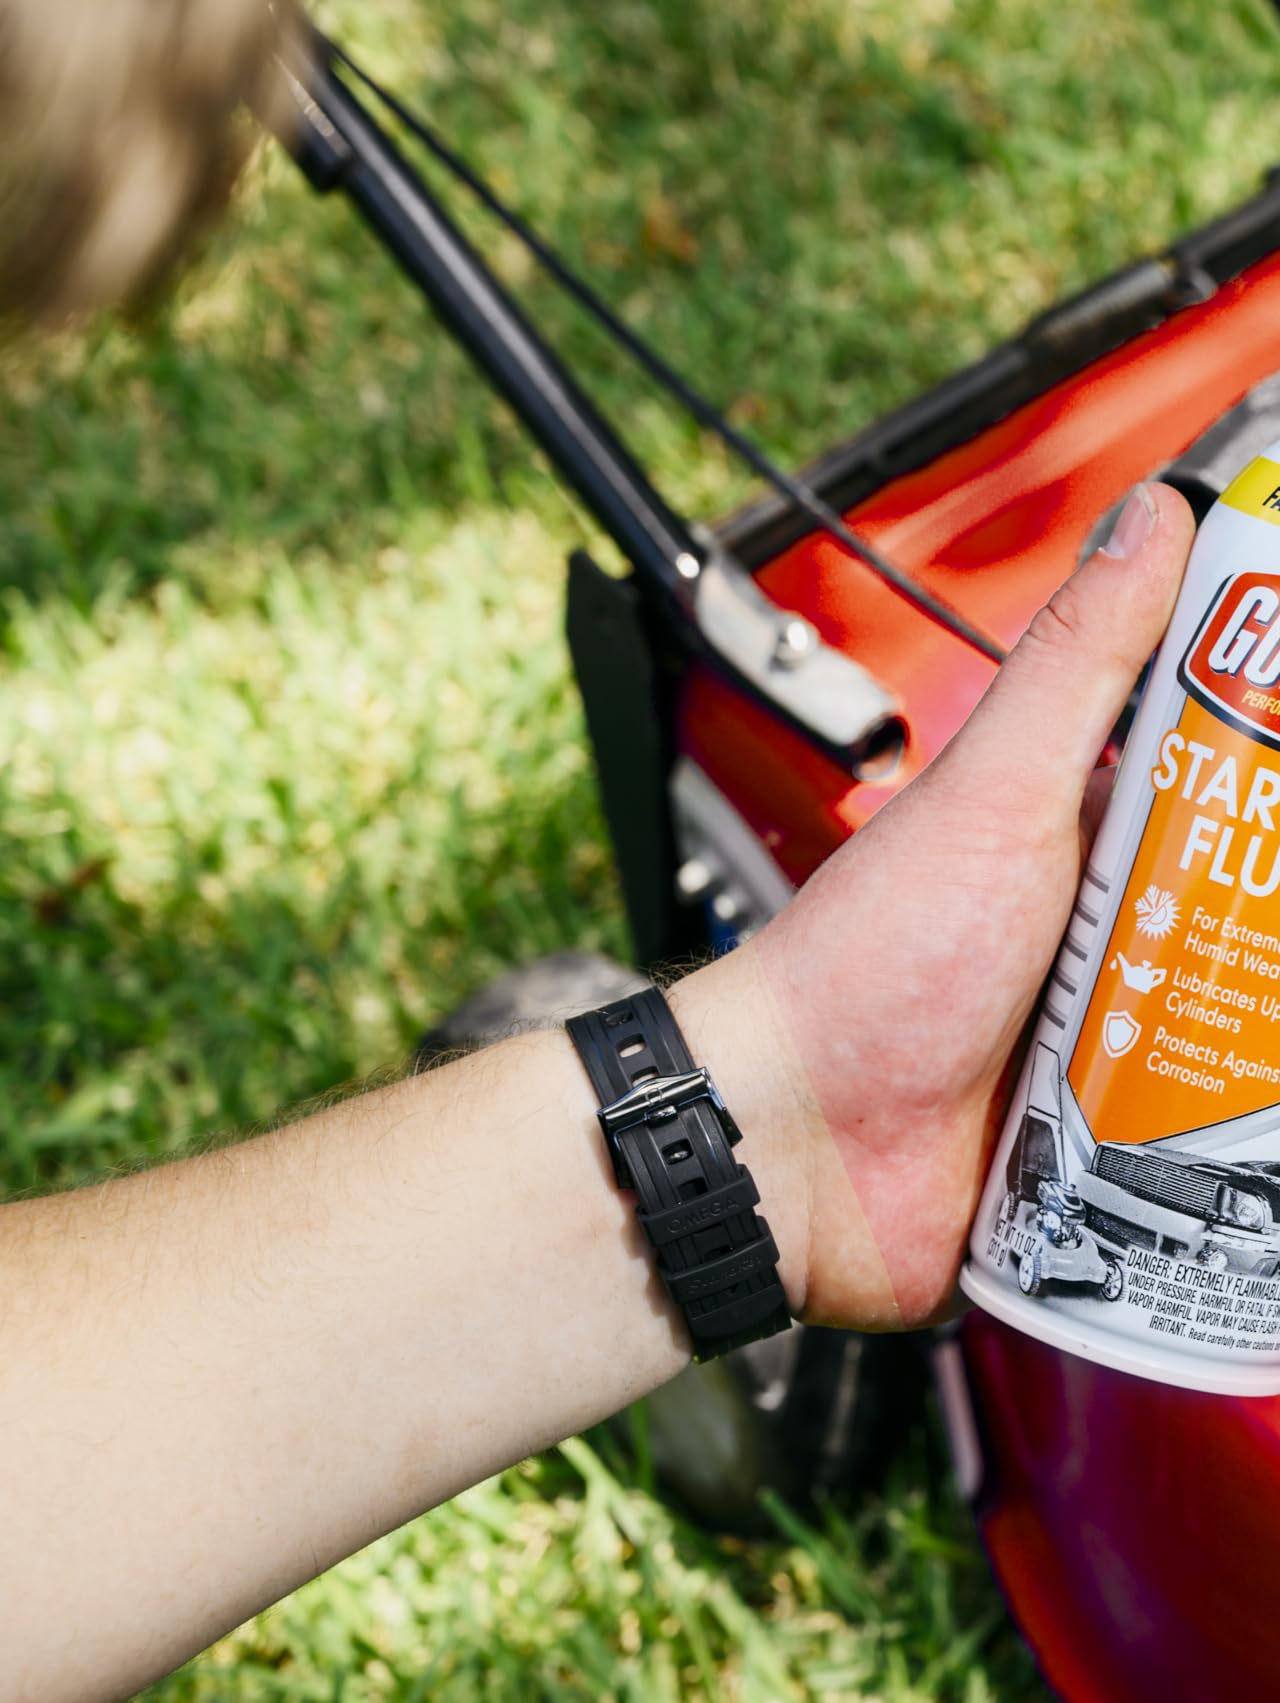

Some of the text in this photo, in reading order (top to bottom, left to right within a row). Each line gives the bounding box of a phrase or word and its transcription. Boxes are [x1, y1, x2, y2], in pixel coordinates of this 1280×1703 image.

[1192, 906, 1219, 932] For
[1184, 931, 1240, 967] Humid
[1172, 966, 1257, 1011] Lubricates
[1166, 991, 1242, 1034] Cylinders
[1153, 1025, 1220, 1065] Protects
[1146, 1051, 1226, 1095] Corrosion
[1014, 1231, 1025, 1250] 11
[1023, 1236, 1036, 1256] OZ
[1127, 1249, 1172, 1279] DANGER:
[1174, 1263, 1233, 1294] EXTREMELY
[1127, 1289, 1155, 1310] VAPOR
[1195, 1308, 1221, 1328] VAPOR
[1221, 1314, 1238, 1330] MAY
[1237, 1317, 1260, 1333] CAUSE
[1128, 1272, 1156, 1292] UNDER
[1198, 1292, 1233, 1312] HARMFUL
[1235, 1299, 1246, 1313] OR
[1245, 1301, 1265, 1317] FATAL
[1149, 1315, 1187, 1337] IRRITANT.
[1188, 1328, 1207, 1342] Read
[1206, 1333, 1235, 1349] carefully
